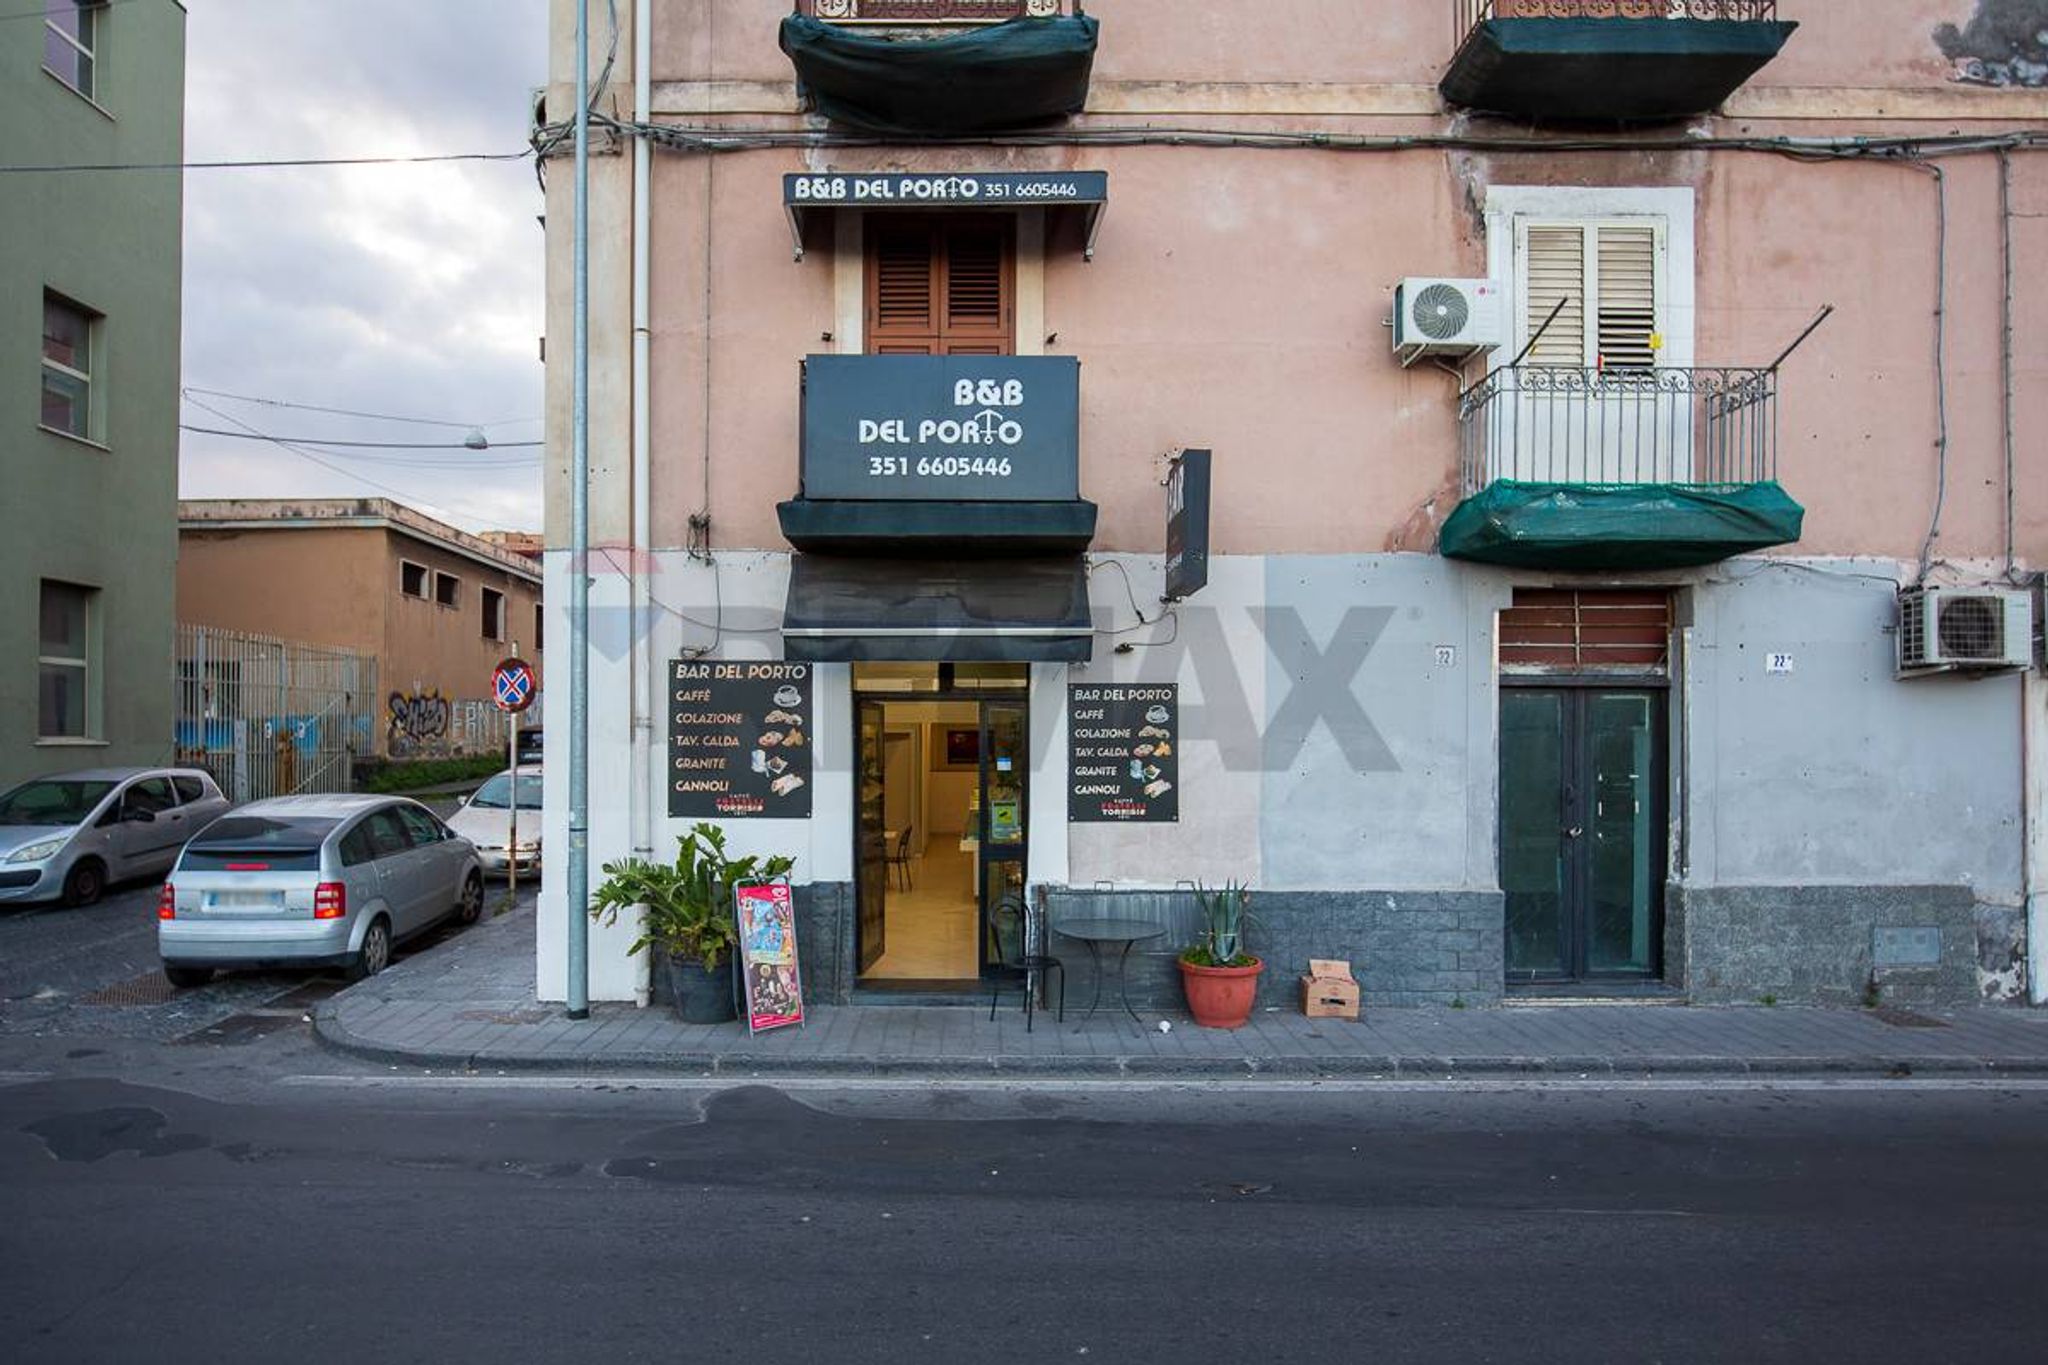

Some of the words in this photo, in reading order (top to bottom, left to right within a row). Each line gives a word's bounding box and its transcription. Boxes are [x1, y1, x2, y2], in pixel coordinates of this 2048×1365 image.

[795, 177, 847, 199] B&B
[854, 179, 894, 198] DEL
[899, 177, 979, 199] PORTO
[984, 184, 1011, 196] 351
[1016, 183, 1077, 197] 6605446
[954, 378, 1024, 406] B&B
[859, 419, 910, 444] DEL
[919, 409, 1024, 445] PORTO
[869, 457, 908, 476] 351
[916, 457, 1012, 476] 6605446
[676, 664, 710, 679] BAR
[715, 665, 744, 679] DEL
[748, 665, 807, 680] PORTO
[1074, 689, 1101, 701] BAR
[1103, 689, 1126, 701] DEL
[1128, 689, 1172, 701] PORTO
[676, 713, 743, 724] COLAZIONE
[1075, 728, 1131, 739] COLAZIONE
[676, 735, 699, 747] TAV.
[702, 735, 740, 747] CALDA
[1075, 747, 1095, 758] TAV.
[1097, 747, 1129, 758] CALDA
[675, 758, 727, 769] GRANITE
[1075, 766, 1117, 777] GRANITE
[675, 780, 729, 792] CANNOLI
[1074, 785, 1120, 795] CANNOLI
